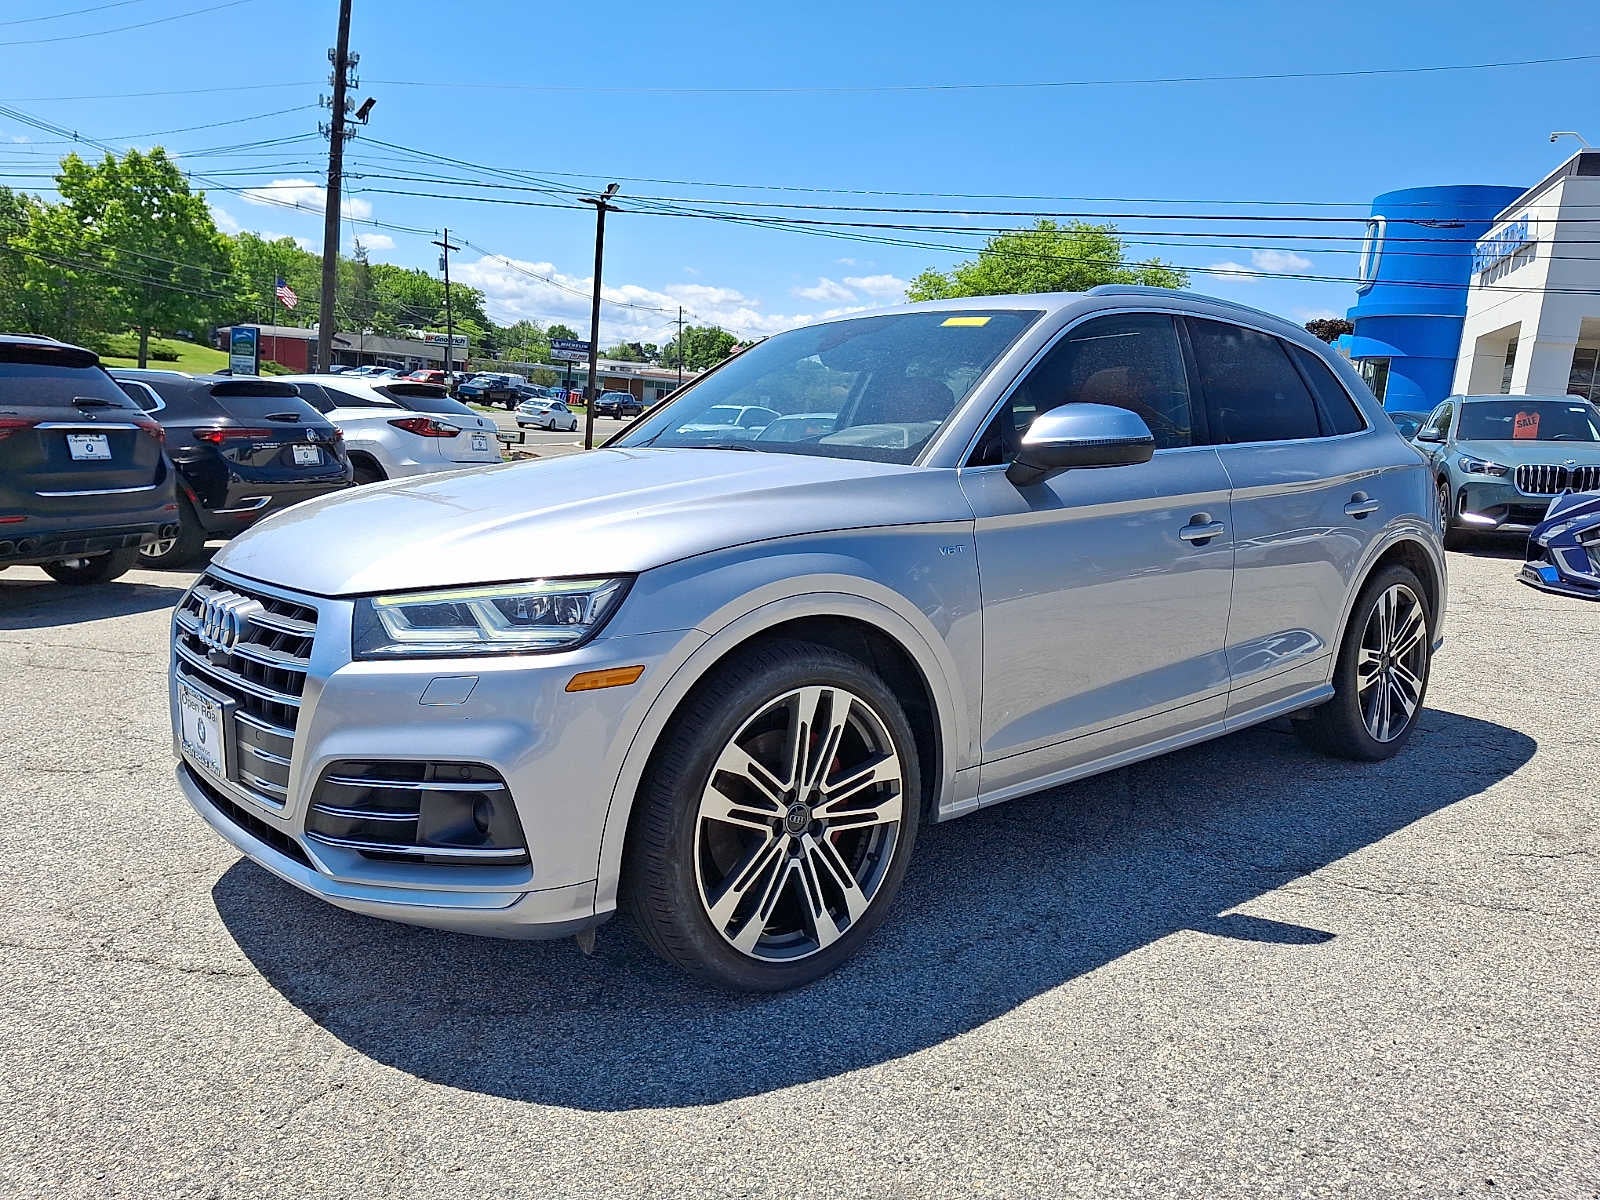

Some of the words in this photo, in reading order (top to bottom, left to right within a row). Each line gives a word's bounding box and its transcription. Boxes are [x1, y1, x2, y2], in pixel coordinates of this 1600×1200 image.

[425, 335, 466, 345] BFGoorich
[1516, 416, 1538, 428] SALE
[181, 693, 200, 713] Open
[201, 704, 218, 722] Roa
